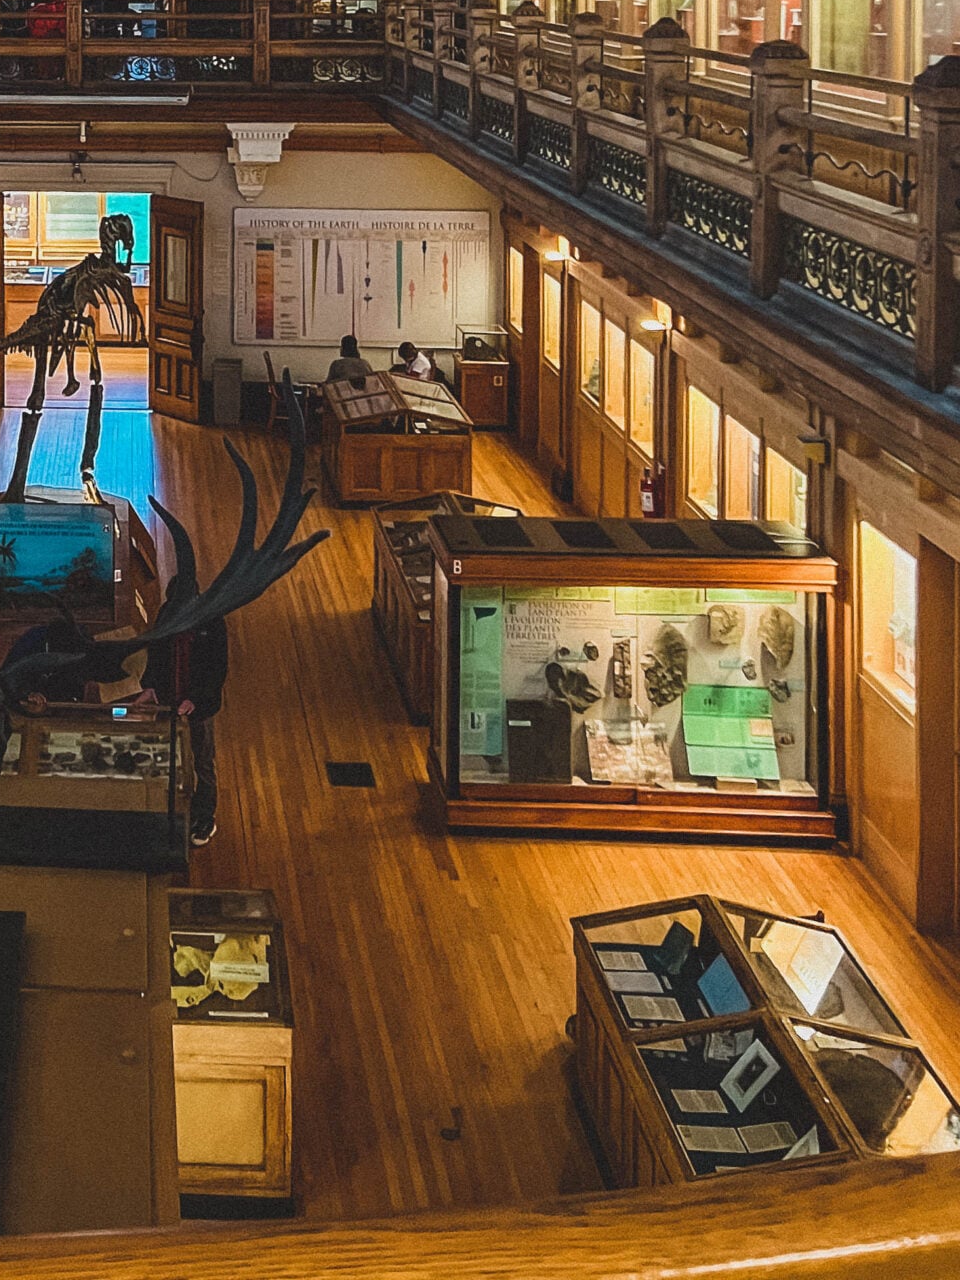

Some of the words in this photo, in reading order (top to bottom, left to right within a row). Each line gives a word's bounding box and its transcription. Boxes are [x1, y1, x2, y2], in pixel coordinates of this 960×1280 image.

[250, 219, 290, 229] HISTORY
[292, 220, 304, 229] OF
[308, 220, 326, 229] THE
[330, 220, 359, 230] EARTH
[371, 221, 414, 230] HISTOIRE
[419, 221, 430, 231] DE
[433, 222, 444, 230] LA
[448, 222, 474, 231] TERRE
[453, 559, 462, 574] B
